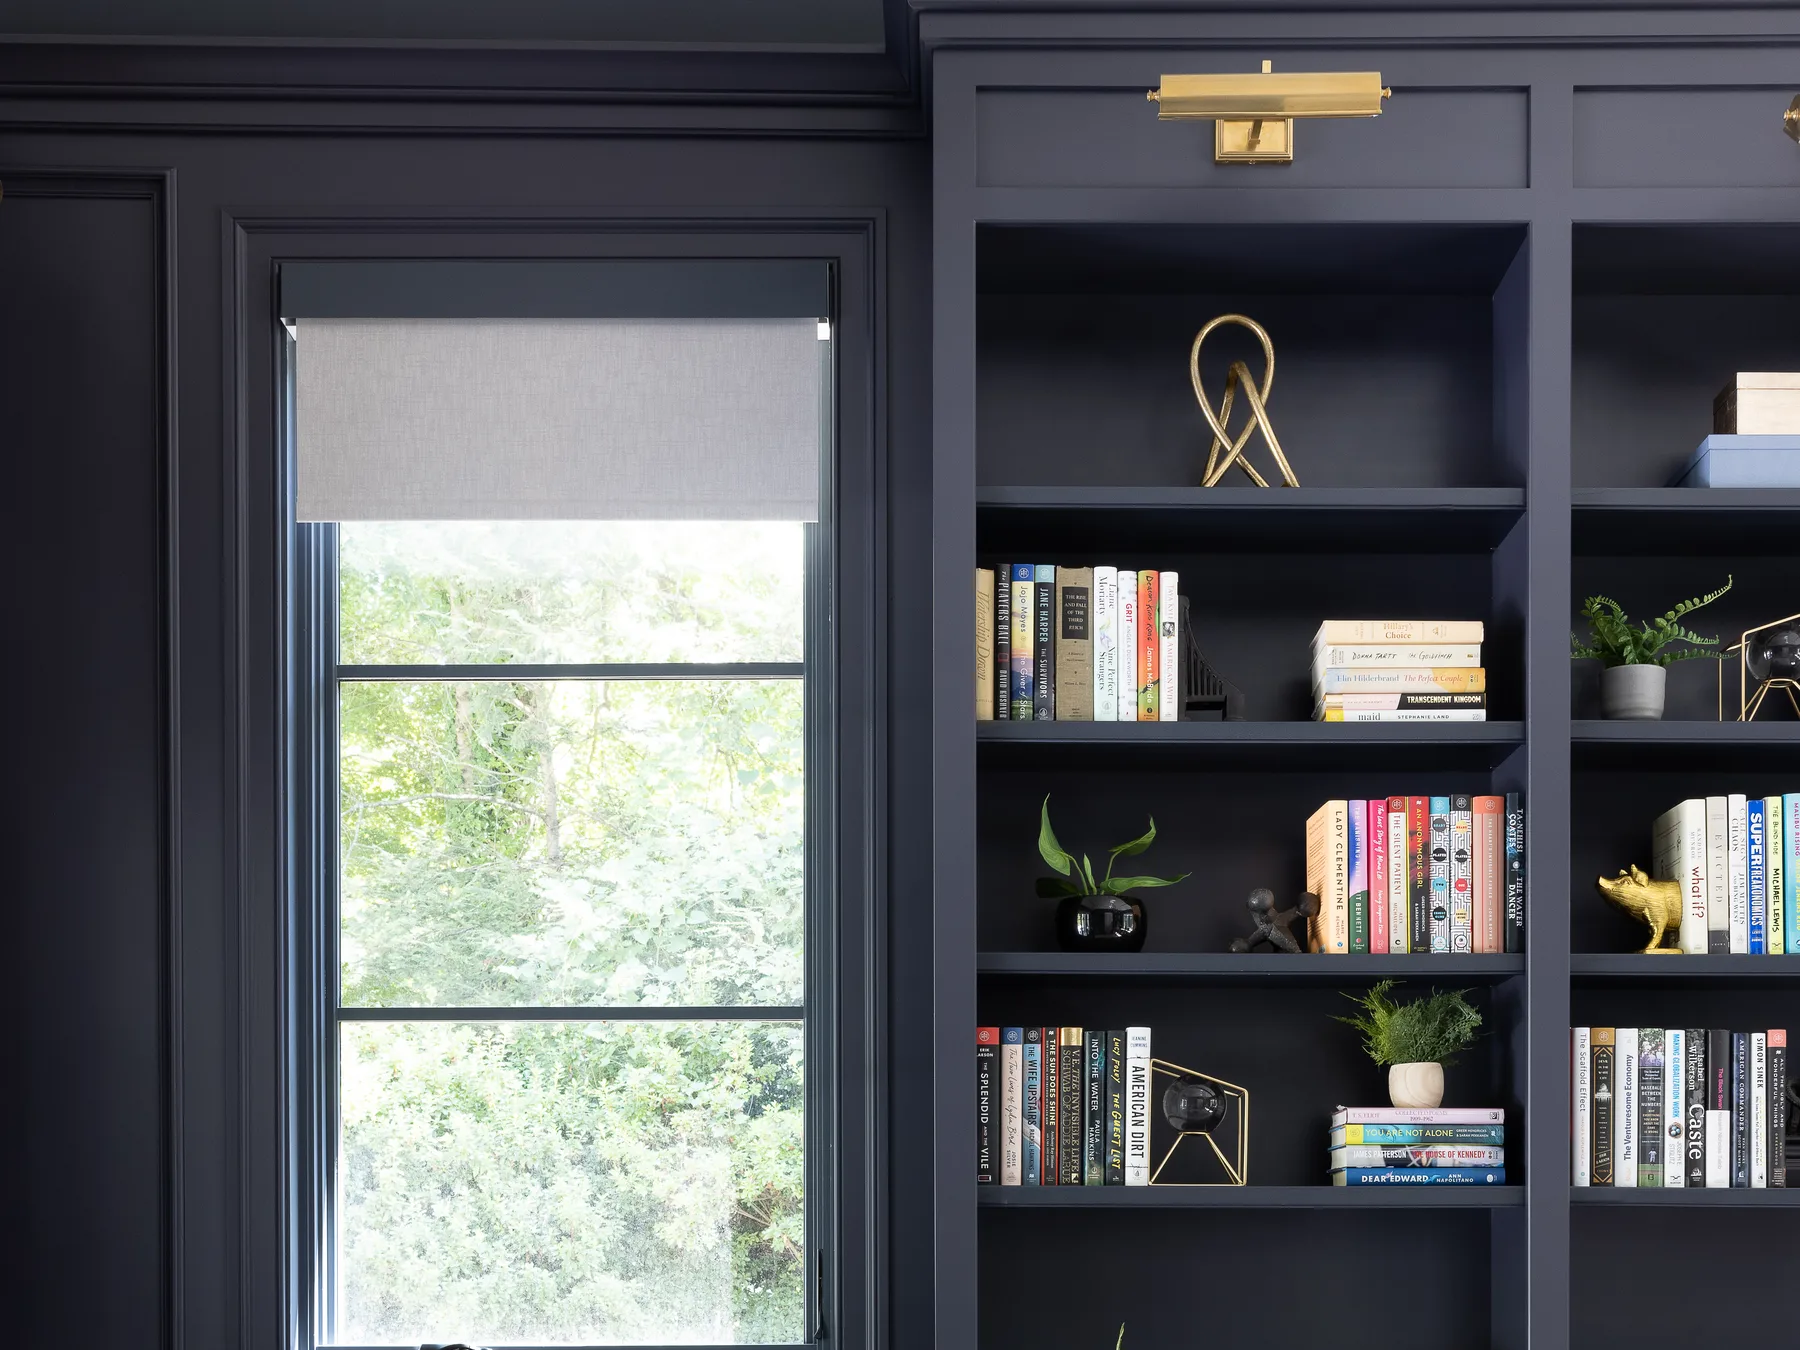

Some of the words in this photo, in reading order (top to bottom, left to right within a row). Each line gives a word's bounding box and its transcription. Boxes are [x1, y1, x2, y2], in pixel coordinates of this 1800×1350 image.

[998, 583, 1009, 621] PLAYERS
[1020, 586, 1028, 603] Jojo
[1040, 588, 1048, 607] JANE
[1096, 576, 1108, 615] Moriarty
[1108, 584, 1116, 609] Liane
[976, 589, 990, 643] Watership
[1125, 603, 1133, 623] GRIT
[998, 624, 1009, 644] BALL
[1040, 610, 1048, 643] HARPER
[1383, 622, 1414, 632] Hillary's
[1385, 631, 1412, 639] Choice
[977, 643, 991, 681] Down
[1020, 652, 1028, 665] The
[1107, 646, 1116, 665] Nine
[1166, 641, 1174, 685] AMERICAN
[1000, 670, 1008, 692] DAVID
[1020, 668, 1028, 689] Giver
[1040, 659, 1048, 699] SURVIVORS
[1097, 652, 1107, 690] Strangers
[1107, 668, 1116, 696] Perfect
[1337, 674, 1352, 682] Elin
[1353, 674, 1399, 682] Hilderbrand
[1404, 674, 1416, 682] The
[1417, 674, 1438, 683] Perfect
[1440, 674, 1463, 683] Couple
[1406, 696, 1451, 704] TRANSCENDENT
[1453, 696, 1481, 704] KINGDOM
[1358, 712, 1381, 721] maid
[1335, 811, 1343, 838] LADY
[1393, 815, 1401, 829] THE
[1416, 808, 1422, 819] AN
[1508, 813, 1516, 847] COATES
[1336, 843, 1344, 910] CLEMENTINE
[1394, 863, 1402, 895] PATIENT
[1751, 813, 1763, 925] SUPERFREAKONOMICS
[1691, 866, 1704, 898] what
[1508, 884, 1516, 919] DANCER
[1692, 902, 1705, 918] if?
[1772, 908, 1780, 933] LEWIS
[1009, 1048, 1018, 1060] The
[1072, 1049, 1080, 1057] V.
[1672, 1033, 1680, 1057] MAKING
[1009, 1060, 1018, 1075] Two
[1028, 1059, 1037, 1081] WIFE
[1062, 1049, 1071, 1093] SCHWAB
[1072, 1058, 1080, 1068] E.
[1624, 1055, 1634, 1091] Economy
[1688, 1045, 1697, 1090] Wilkerson
[1008, 1077, 1018, 1093] Lives
[1072, 1068, 1080, 1091] THE
[1672, 1057, 1680, 1100] GLOBALIZATION
[980, 1073, 989, 1123] SPLENDID
[1009, 1096, 1017, 1104] of
[1027, 1084, 1037, 1126] UPSTAIRS
[1062, 1095, 1071, 1110] OF
[1131, 1065, 1145, 1127] AMERICAN
[1005, 1105, 1017, 1125] Lydia
[1072, 1092, 1080, 1146] INVISIBLE
[1672, 1101, 1680, 1118] WORK
[1008, 1126, 1017, 1145] Bird
[1062, 1111, 1071, 1146] ADDIE
[1112, 1110, 1122, 1147] GUEST
[1689, 1104, 1705, 1160] Caste
[1131, 1132, 1145, 1159] DIRT
[1353, 1151, 1371, 1159] JAMES
[1372, 1151, 1407, 1159] PATTERSON
[1411, 1151, 1424, 1159] THE
[1425, 1151, 1446, 1159] HOUSE
[1447, 1151, 1456, 1159] OF
[1457, 1151, 1486, 1159] KENNEDY
[980, 1148, 989, 1169] VILE
[1072, 1147, 1080, 1172] LIFE
[1111, 1149, 1121, 1169] LIST
[1362, 1175, 1386, 1183] DEAR
[1390, 1174, 1429, 1183] EDWARD
